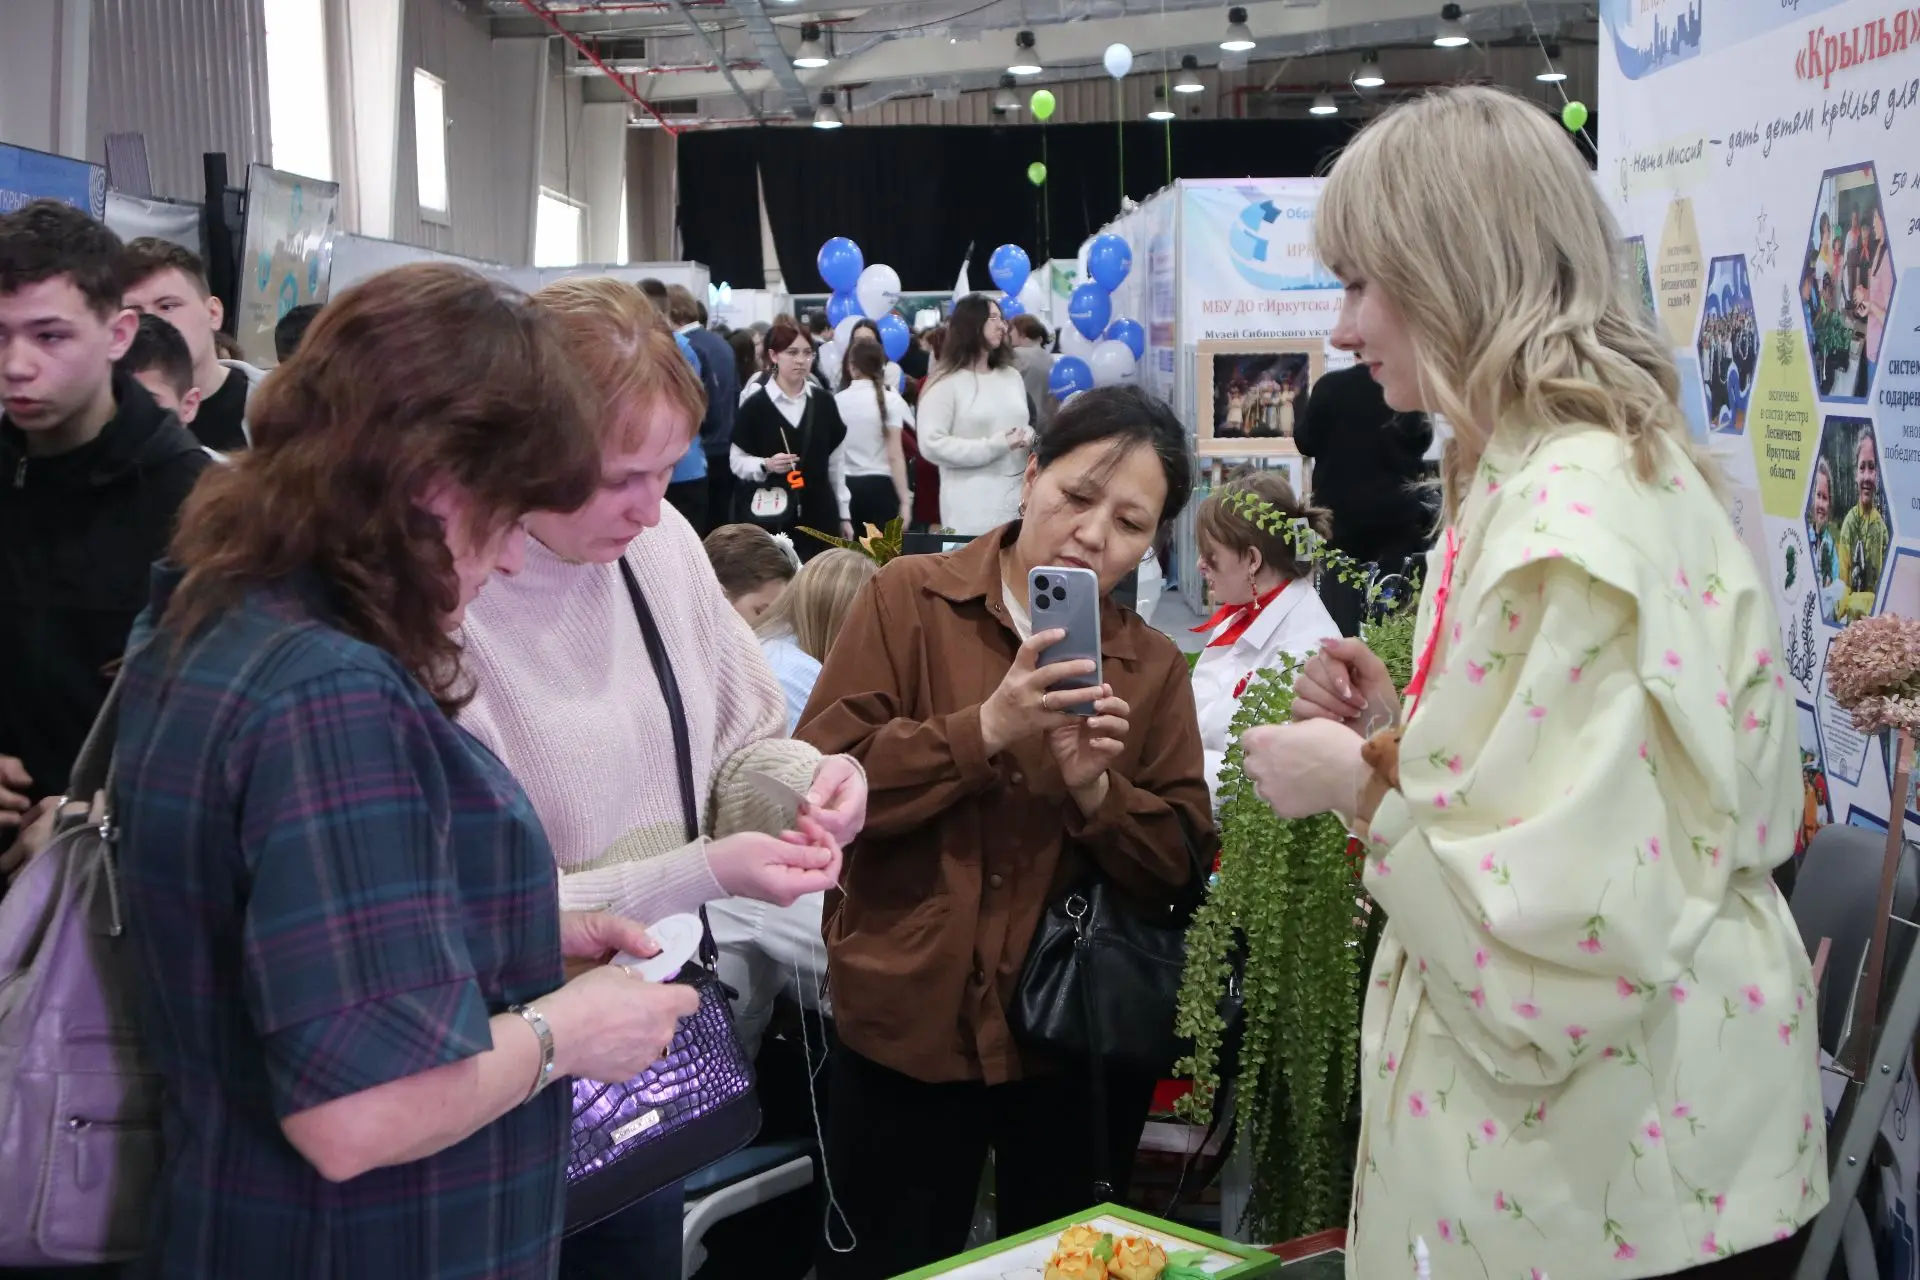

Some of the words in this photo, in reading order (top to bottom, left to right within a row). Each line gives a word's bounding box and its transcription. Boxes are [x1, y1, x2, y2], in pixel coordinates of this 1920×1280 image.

[1795, 7, 1920, 90] «Крылья»
[1633, 152, 1663, 173] Наша
[1665, 138, 1703, 166] Миссия
[1727, 120, 1759, 167] дать
[1763, 107, 1814, 158] детям
[1822, 89, 1880, 142] крылья
[1884, 78, 1919, 130] для
[1889, 171, 1908, 196] 50
[1203, 299, 1232, 313] МБУ
[1235, 299, 1255, 316] ДО
[1205, 329, 1239, 339] Музей
[1242, 328, 1306, 339] Сибирского
[1766, 446, 1801, 463] Иркутской
[1769, 464, 1796, 480] области
